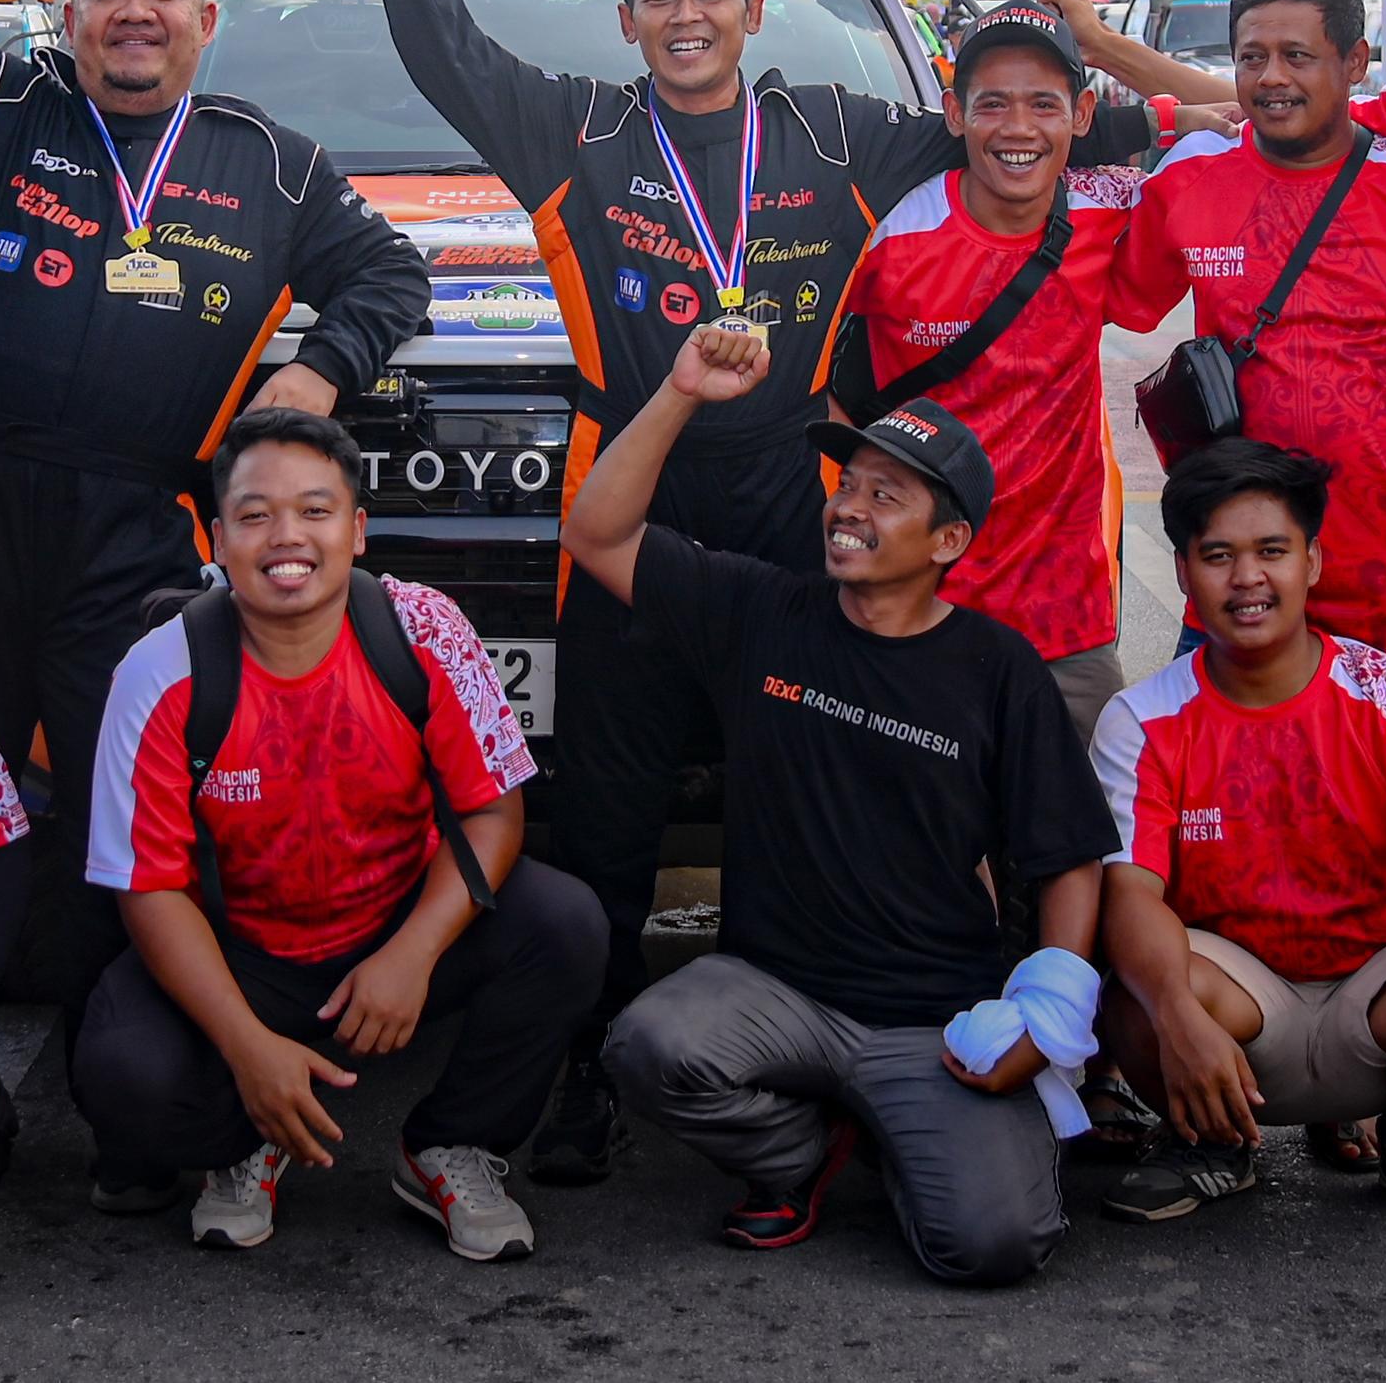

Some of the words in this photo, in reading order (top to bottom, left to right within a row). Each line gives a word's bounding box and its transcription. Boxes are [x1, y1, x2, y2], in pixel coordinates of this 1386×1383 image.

[1009, 6, 1058, 26] RACING
[16, 190, 101, 240] Gallop
[605, 204, 668, 238] Gallop
[155, 221, 254, 264] Takatrans
[621, 227, 708, 273] Gallop
[744, 236, 834, 267] Takatrans
[1202, 245, 1245, 262] RACING
[618, 274, 643, 299] TAKA
[892, 409, 940, 437] RACING
[360, 449, 552, 492] TOYO
[802, 687, 865, 726] RACING
[866, 710, 961, 762] INDONESIA
[216, 767, 261, 787] RACING
[1181, 807, 1222, 825] RACING
[1178, 824, 1224, 842] NESIA
